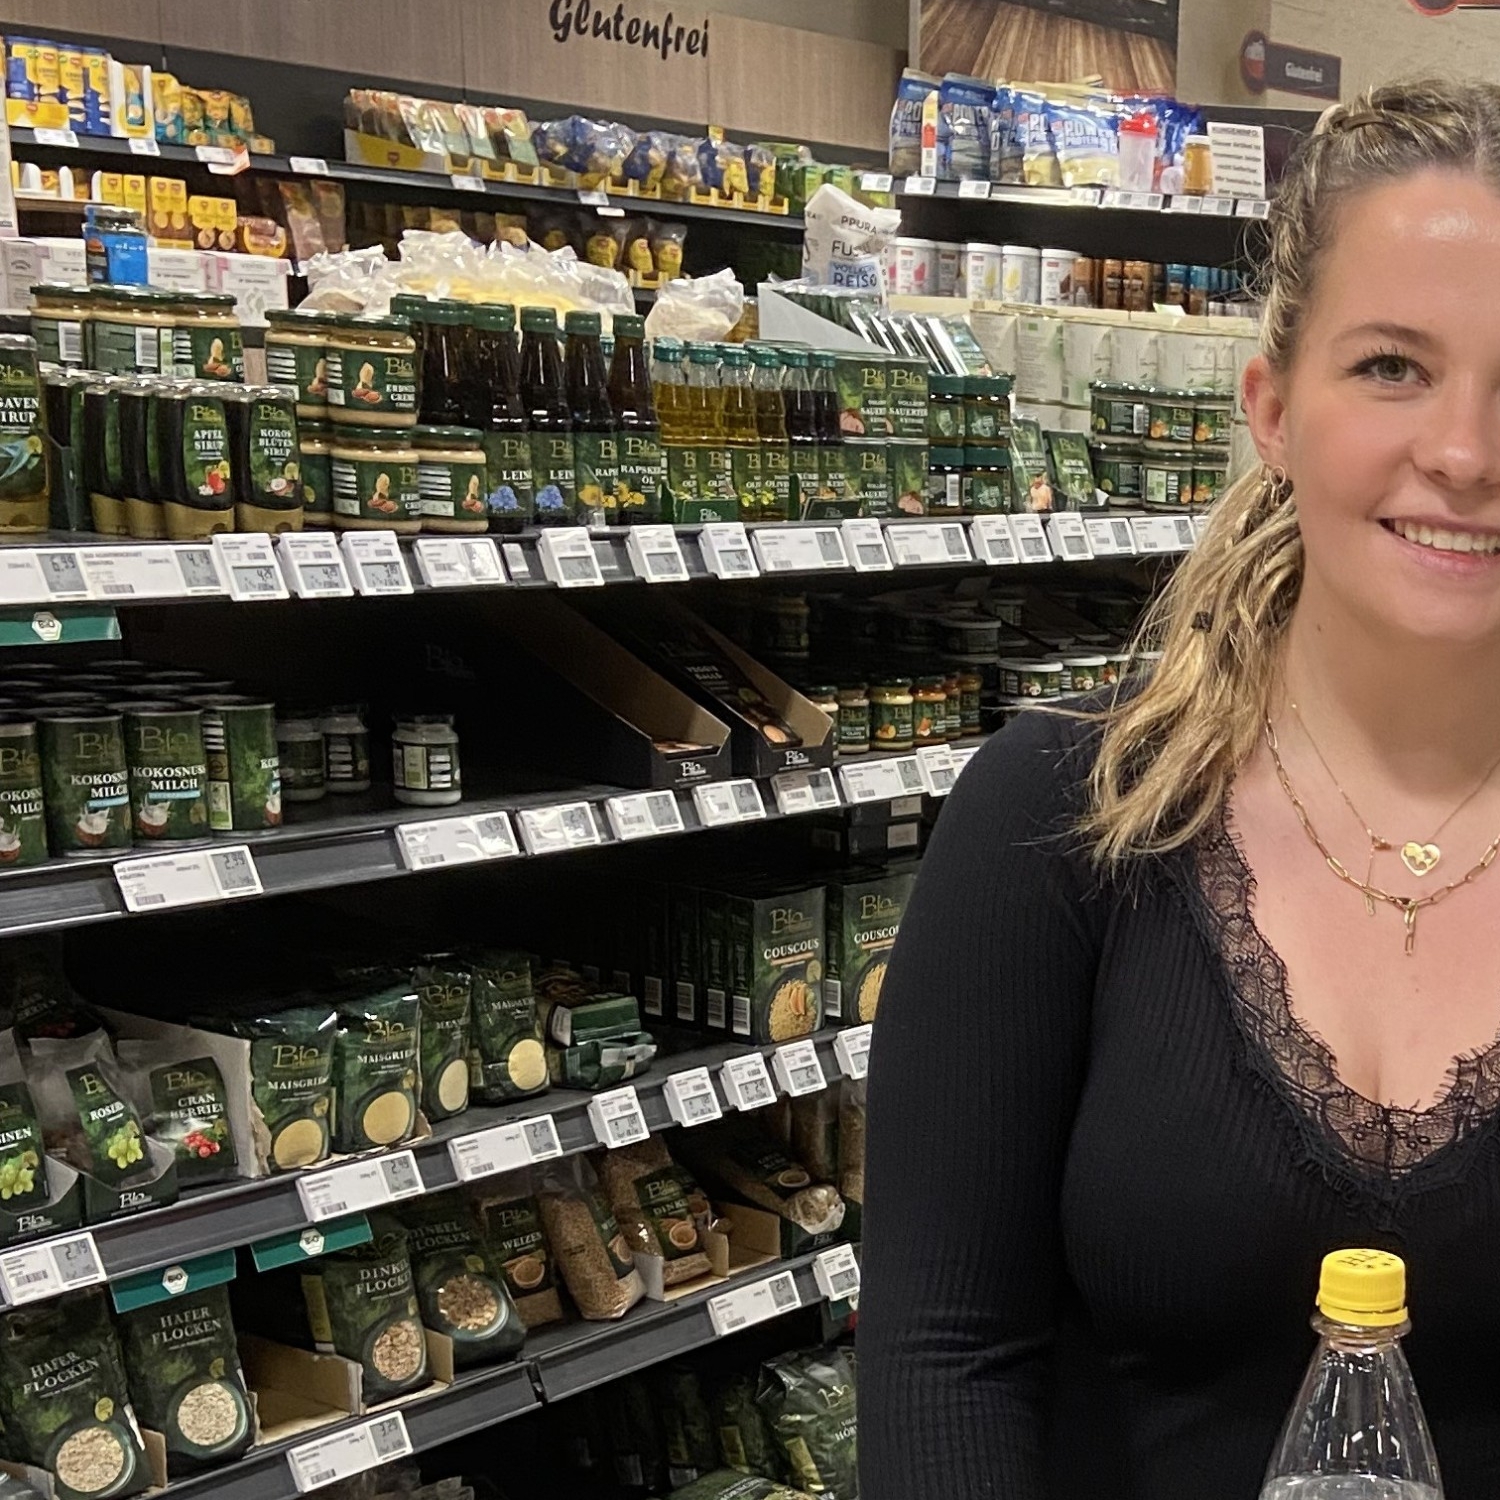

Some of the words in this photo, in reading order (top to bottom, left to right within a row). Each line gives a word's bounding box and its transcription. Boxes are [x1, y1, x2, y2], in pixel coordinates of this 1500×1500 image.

[549, 0, 710, 58] Glutenfrei
[194, 430, 223, 440] APFEL
[194, 440, 224, 451] SIRUP
[151, 778, 198, 791] MILCH
[763, 938, 820, 960] COUSCOUS
[178, 1093, 216, 1108] CRAN
[160, 1306, 212, 1329] HAFER
[152, 1318, 222, 1346] FLOCKEN
[30, 1351, 81, 1379] HAFER
[23, 1357, 100, 1396] FLOCKEN
